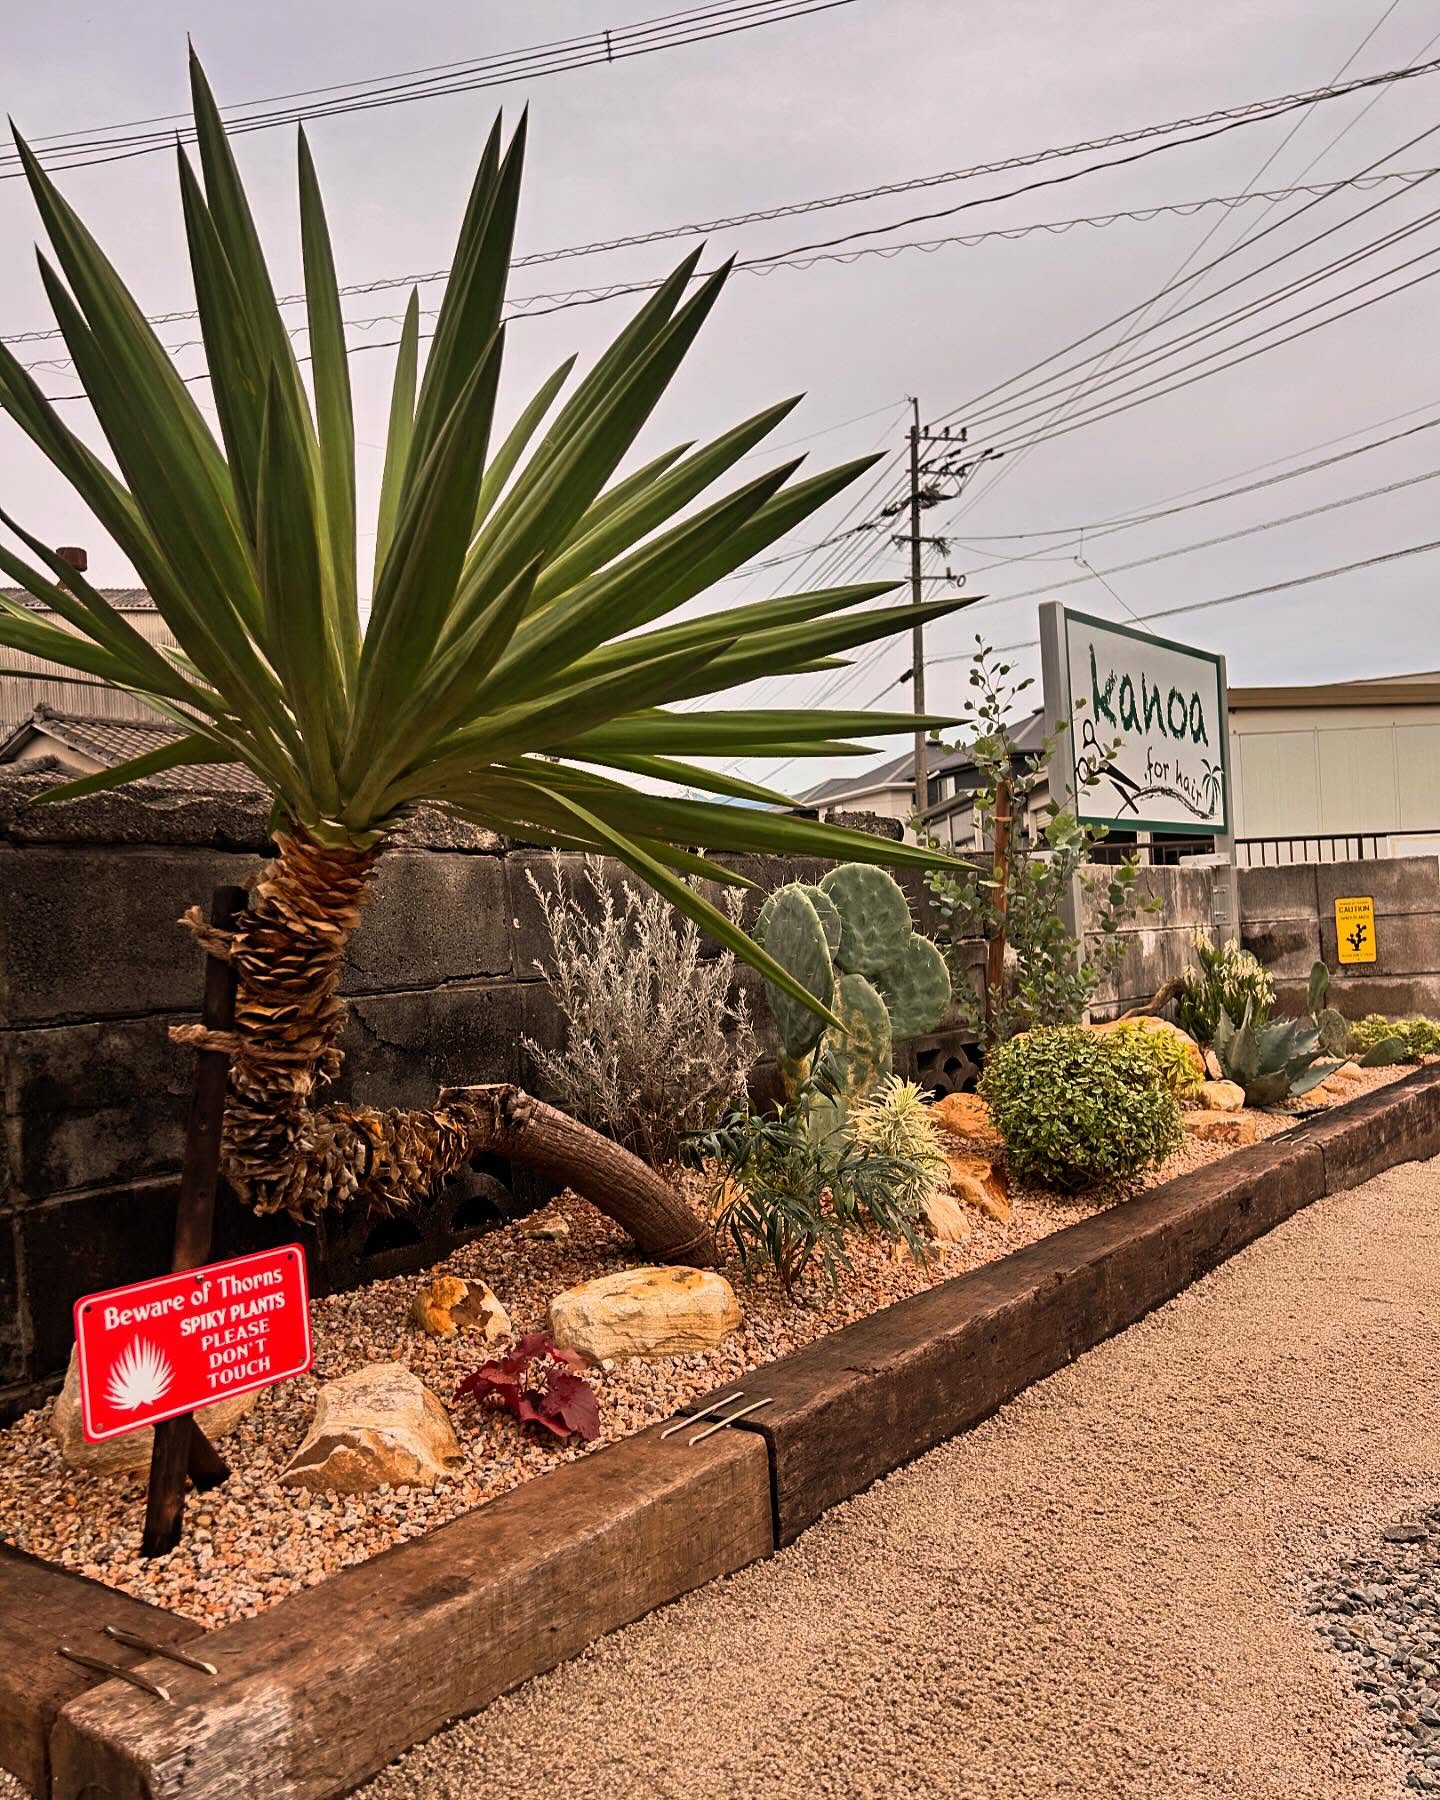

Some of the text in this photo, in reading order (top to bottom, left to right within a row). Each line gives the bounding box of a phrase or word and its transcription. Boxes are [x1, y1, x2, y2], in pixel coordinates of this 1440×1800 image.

[1089, 641, 1208, 747] kanoa
[1144, 746, 1203, 806] for hair
[104, 1268, 283, 1330] Beware of Thorns
[180, 1292, 285, 1336] SPIKY PLANTS
[201, 1318, 270, 1351] PLEASE
[209, 1338, 267, 1369] DON'T
[207, 1356, 271, 1388] TOUCH
